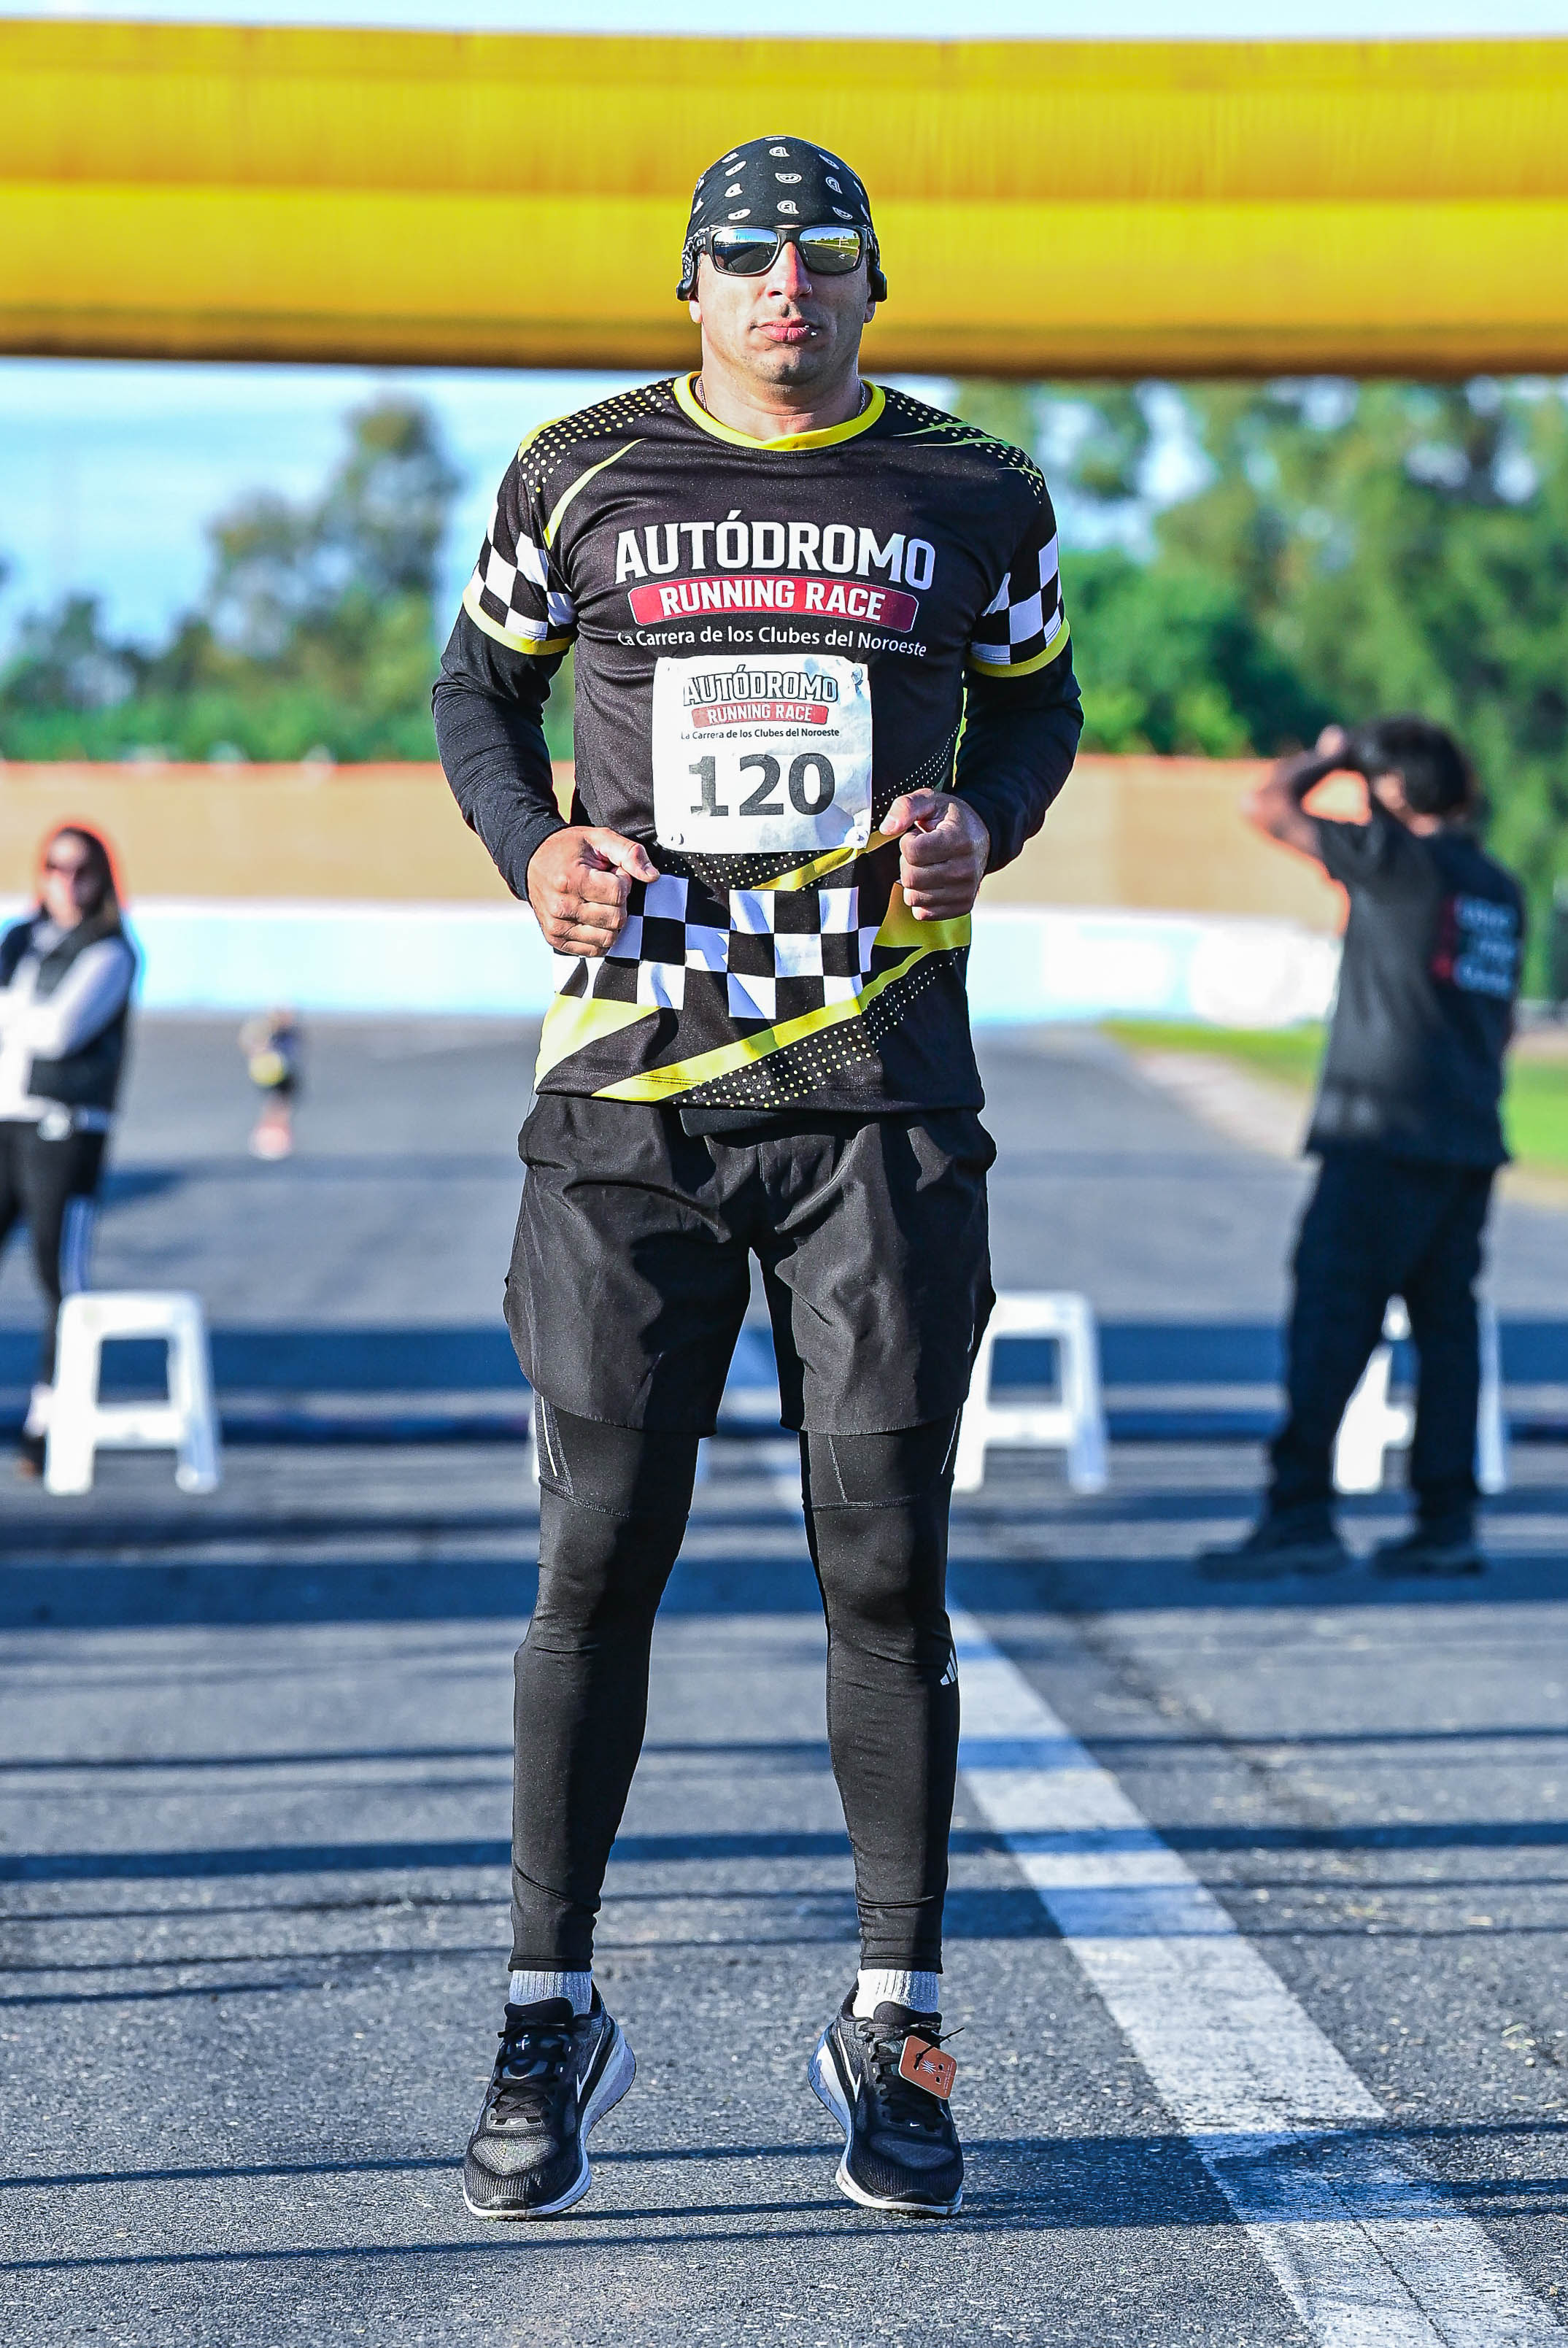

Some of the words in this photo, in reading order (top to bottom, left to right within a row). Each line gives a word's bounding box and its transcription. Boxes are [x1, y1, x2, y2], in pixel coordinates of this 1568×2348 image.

[615, 510, 935, 590] AUTÓDROMO
[658, 579, 795, 617] RUNNING
[805, 582, 887, 622] RACE
[636, 630, 695, 646] Carrera
[700, 625, 723, 643] de
[728, 625, 754, 643] los
[758, 626, 821, 645] Clubes
[824, 629, 854, 648] del
[857, 632, 927, 657] Noroeste
[683, 664, 839, 706] AUTÓDROMO
[681, 730, 690, 740] La
[692, 730, 725, 740] Carrera
[726, 729, 738, 739] de
[740, 729, 753, 738] los
[754, 728, 784, 738] Clubes
[786, 727, 800, 738] del
[801, 727, 841, 737] Noroeste
[707, 703, 771, 723] RUNNING
[775, 704, 813, 722] RACE
[688, 752, 835, 816] 120
